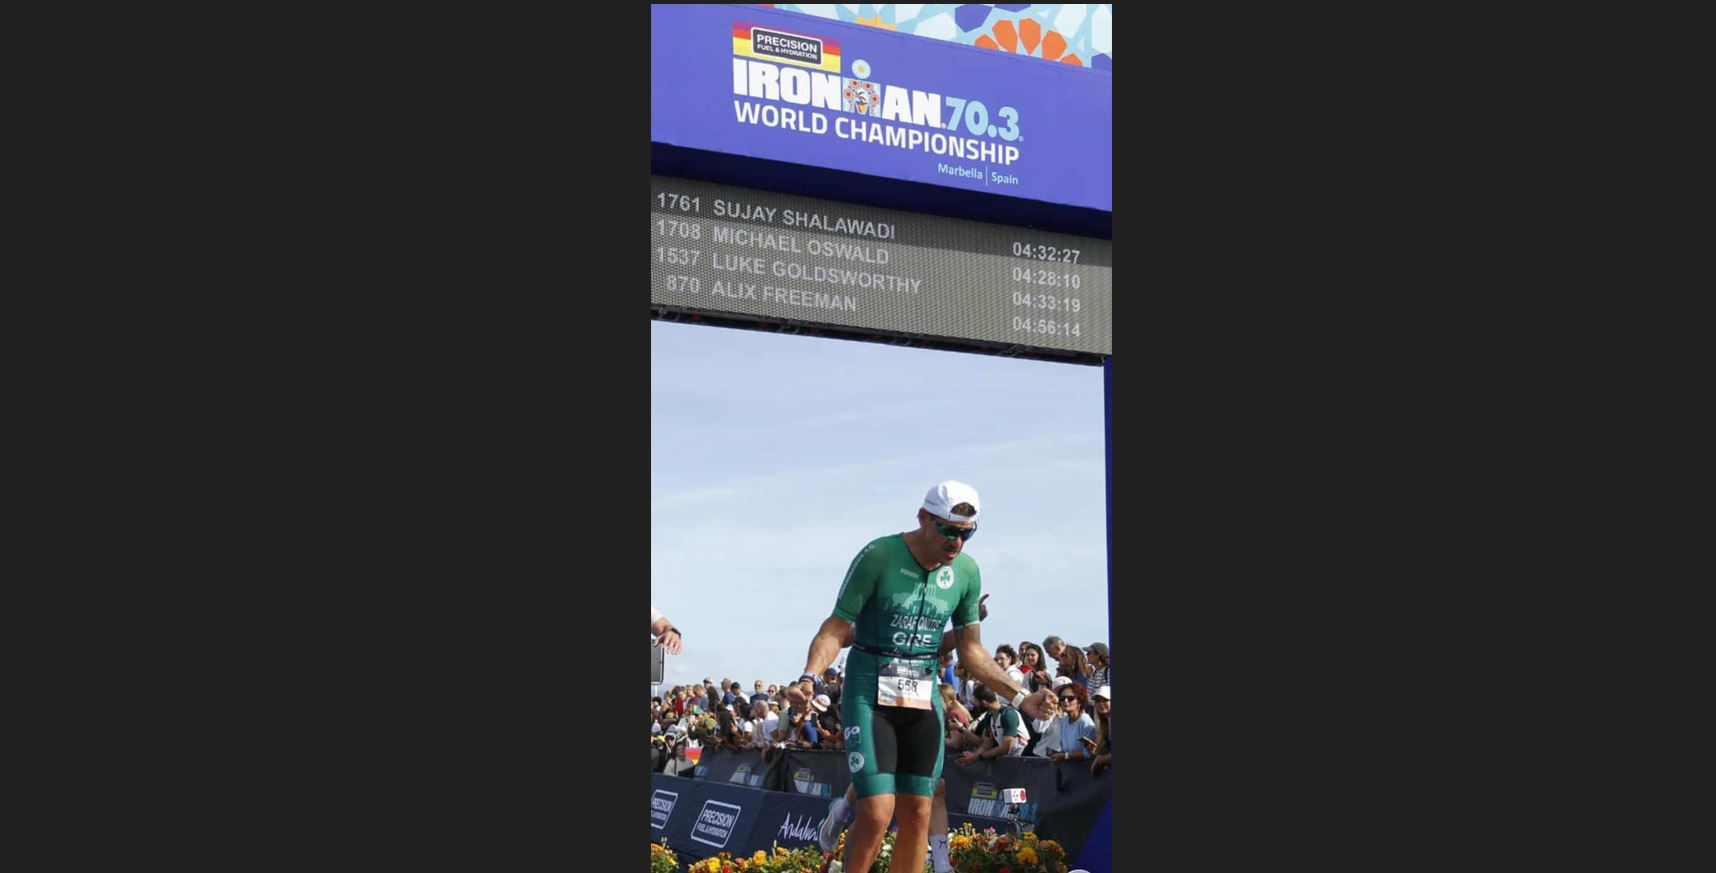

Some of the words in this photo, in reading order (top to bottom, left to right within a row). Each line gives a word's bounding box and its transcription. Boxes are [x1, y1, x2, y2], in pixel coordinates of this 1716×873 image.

[757, 34, 817, 53] PRECISION
[757, 44, 774, 52] FUEL
[781, 48, 818, 60] HYDRATION
[734, 100, 827, 134] WORLD
[835, 117, 1019, 165] CHAMPIONSHIP
[938, 163, 983, 179] Marbella
[991, 172, 1018, 185] Spain
[658, 192, 700, 212] 1761
[713, 199, 776, 222] SUJAY
[783, 209, 895, 239] SHALAWADI
[1013, 242, 1080, 264] 04:32:27
[657, 219, 701, 240] 1708
[713, 226, 801, 253] MICHAEL
[808, 240, 889, 264] OSWALD
[1013, 267, 1080, 289] 04:28:10
[657, 246, 699, 265] 1537
[713, 253, 766, 274] LUKE
[772, 261, 921, 293] GOLDSWORTHY
[1013, 292, 1080, 312] 04:33:19
[667, 275, 699, 293] 870
[712, 281, 757, 300] ALIX
[764, 286, 856, 311] FREEMAN
[1013, 317, 1080, 337] 04:56:14
[892, 632, 932, 647] GRE
[897, 679, 918, 692] 558
[701, 809, 735, 828] PRECISION
